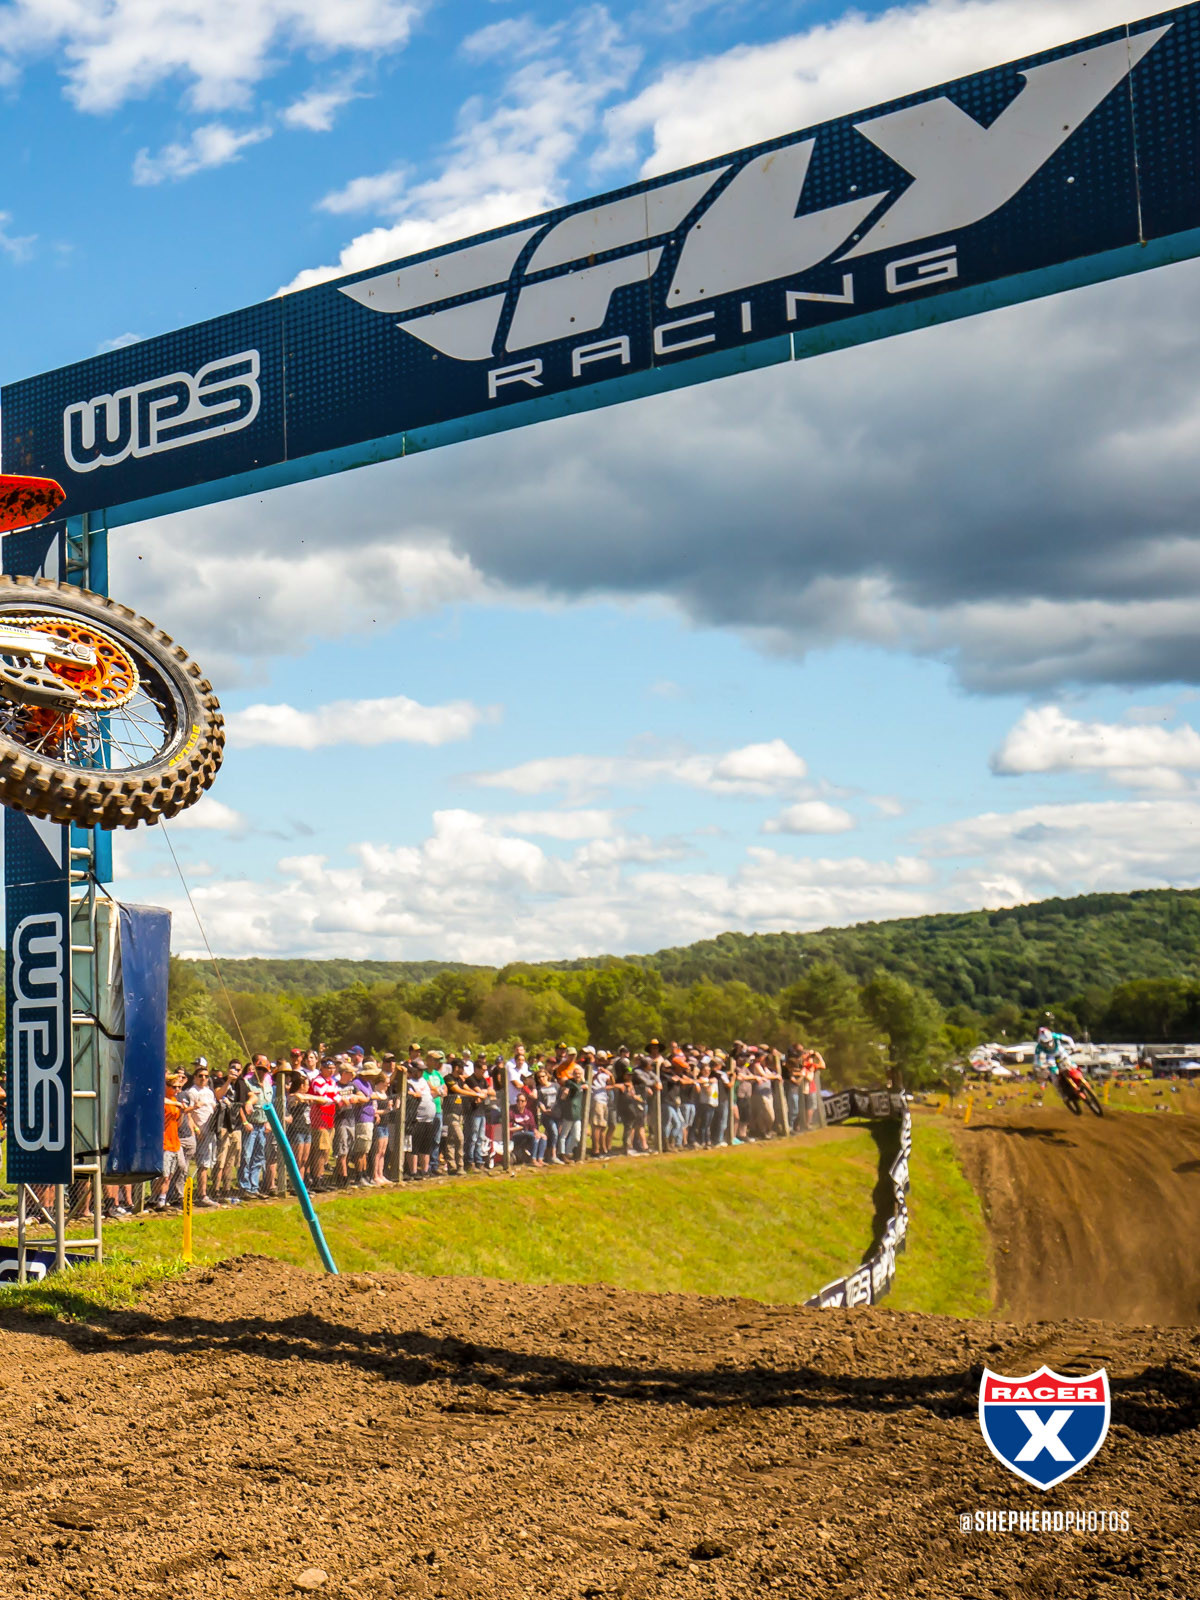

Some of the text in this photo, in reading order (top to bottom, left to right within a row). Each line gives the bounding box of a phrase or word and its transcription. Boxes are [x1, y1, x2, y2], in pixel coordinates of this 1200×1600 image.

[338, 21, 1174, 361] FLY
[488, 244, 960, 399] RACING
[63, 348, 261, 473] WPS
[168, 723, 200, 767] DUNLOP
[12, 912, 65, 1152] WPS
